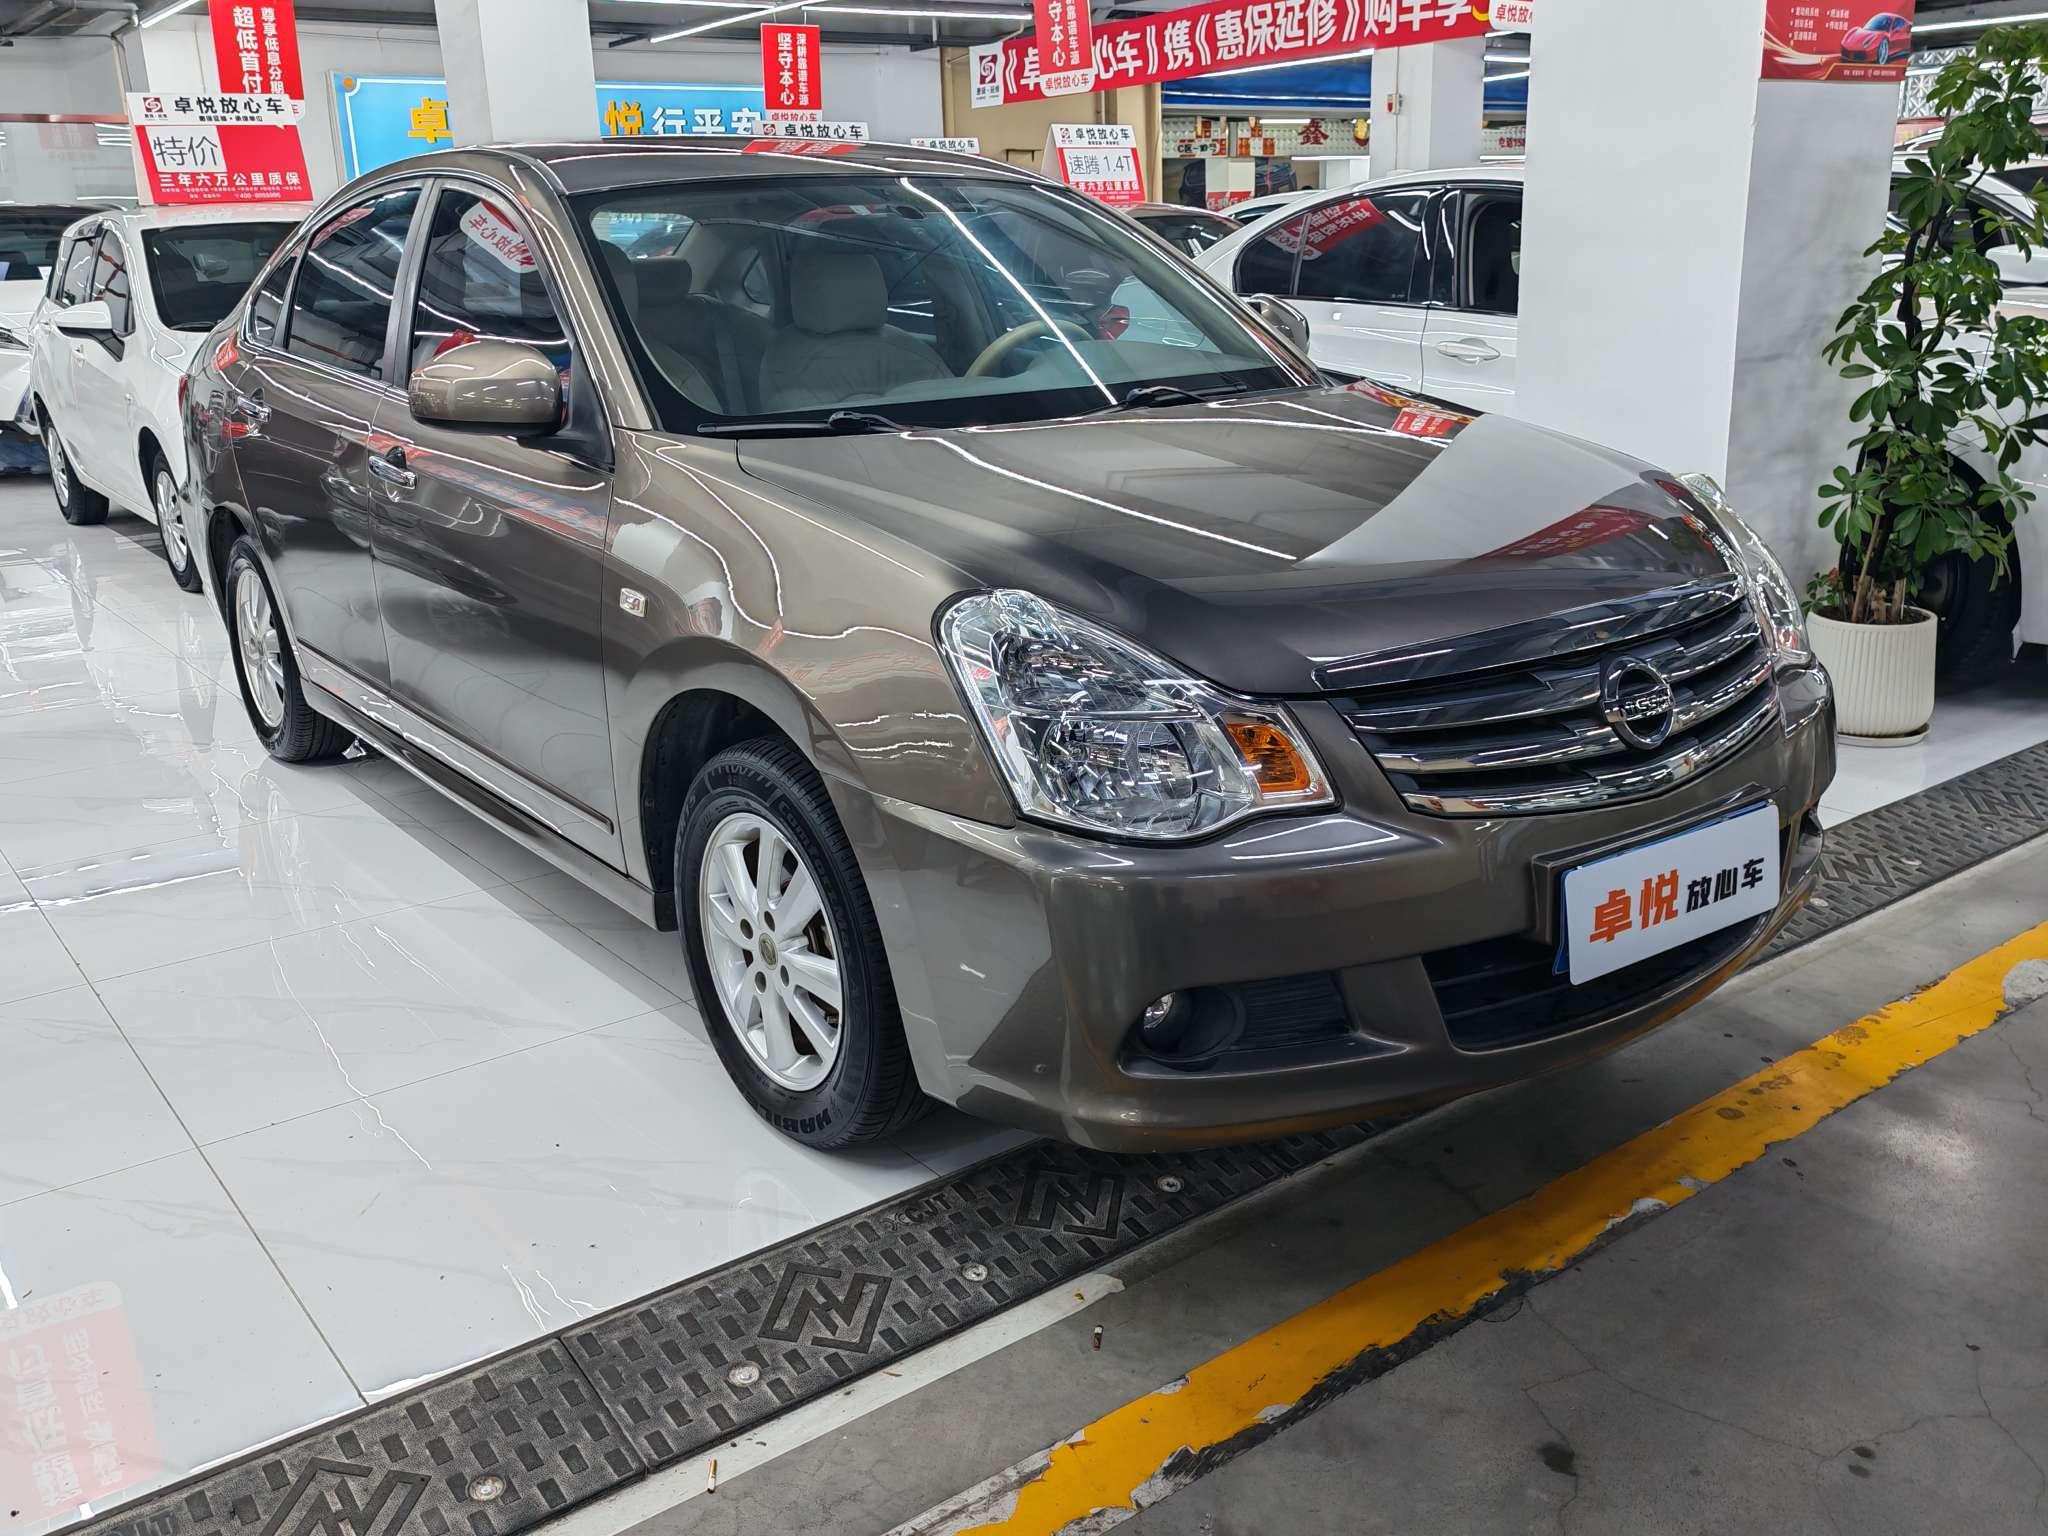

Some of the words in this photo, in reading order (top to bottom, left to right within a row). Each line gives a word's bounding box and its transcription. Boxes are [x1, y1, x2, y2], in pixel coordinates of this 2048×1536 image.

[1496, 4, 1532, 24] 卓悦放
[1066, 0, 1080, 65] 靠谱车源
[232, 6, 263, 93] 超低首付
[260, 7, 285, 94] 尊享低息分期
[777, 32, 795, 106] 坚守本心
[1045, 73, 1090, 91] 卓悦放心车
[174, 96, 285, 115] 卓悦放心车
[407, 96, 453, 143] 卓
[771, 112, 818, 122] 卓悦放心车
[784, 123, 863, 139] 卓悦放心车
[1075, 128, 1130, 140] 卓悦放心车
[153, 136, 218, 167] 特价
[1069, 155, 1100, 175] 速腾
[1103, 155, 1131, 172] 1.4T
[158, 172, 300, 187] 三年六万公里质保
[1589, 857, 1765, 944] 卓悦放心车
